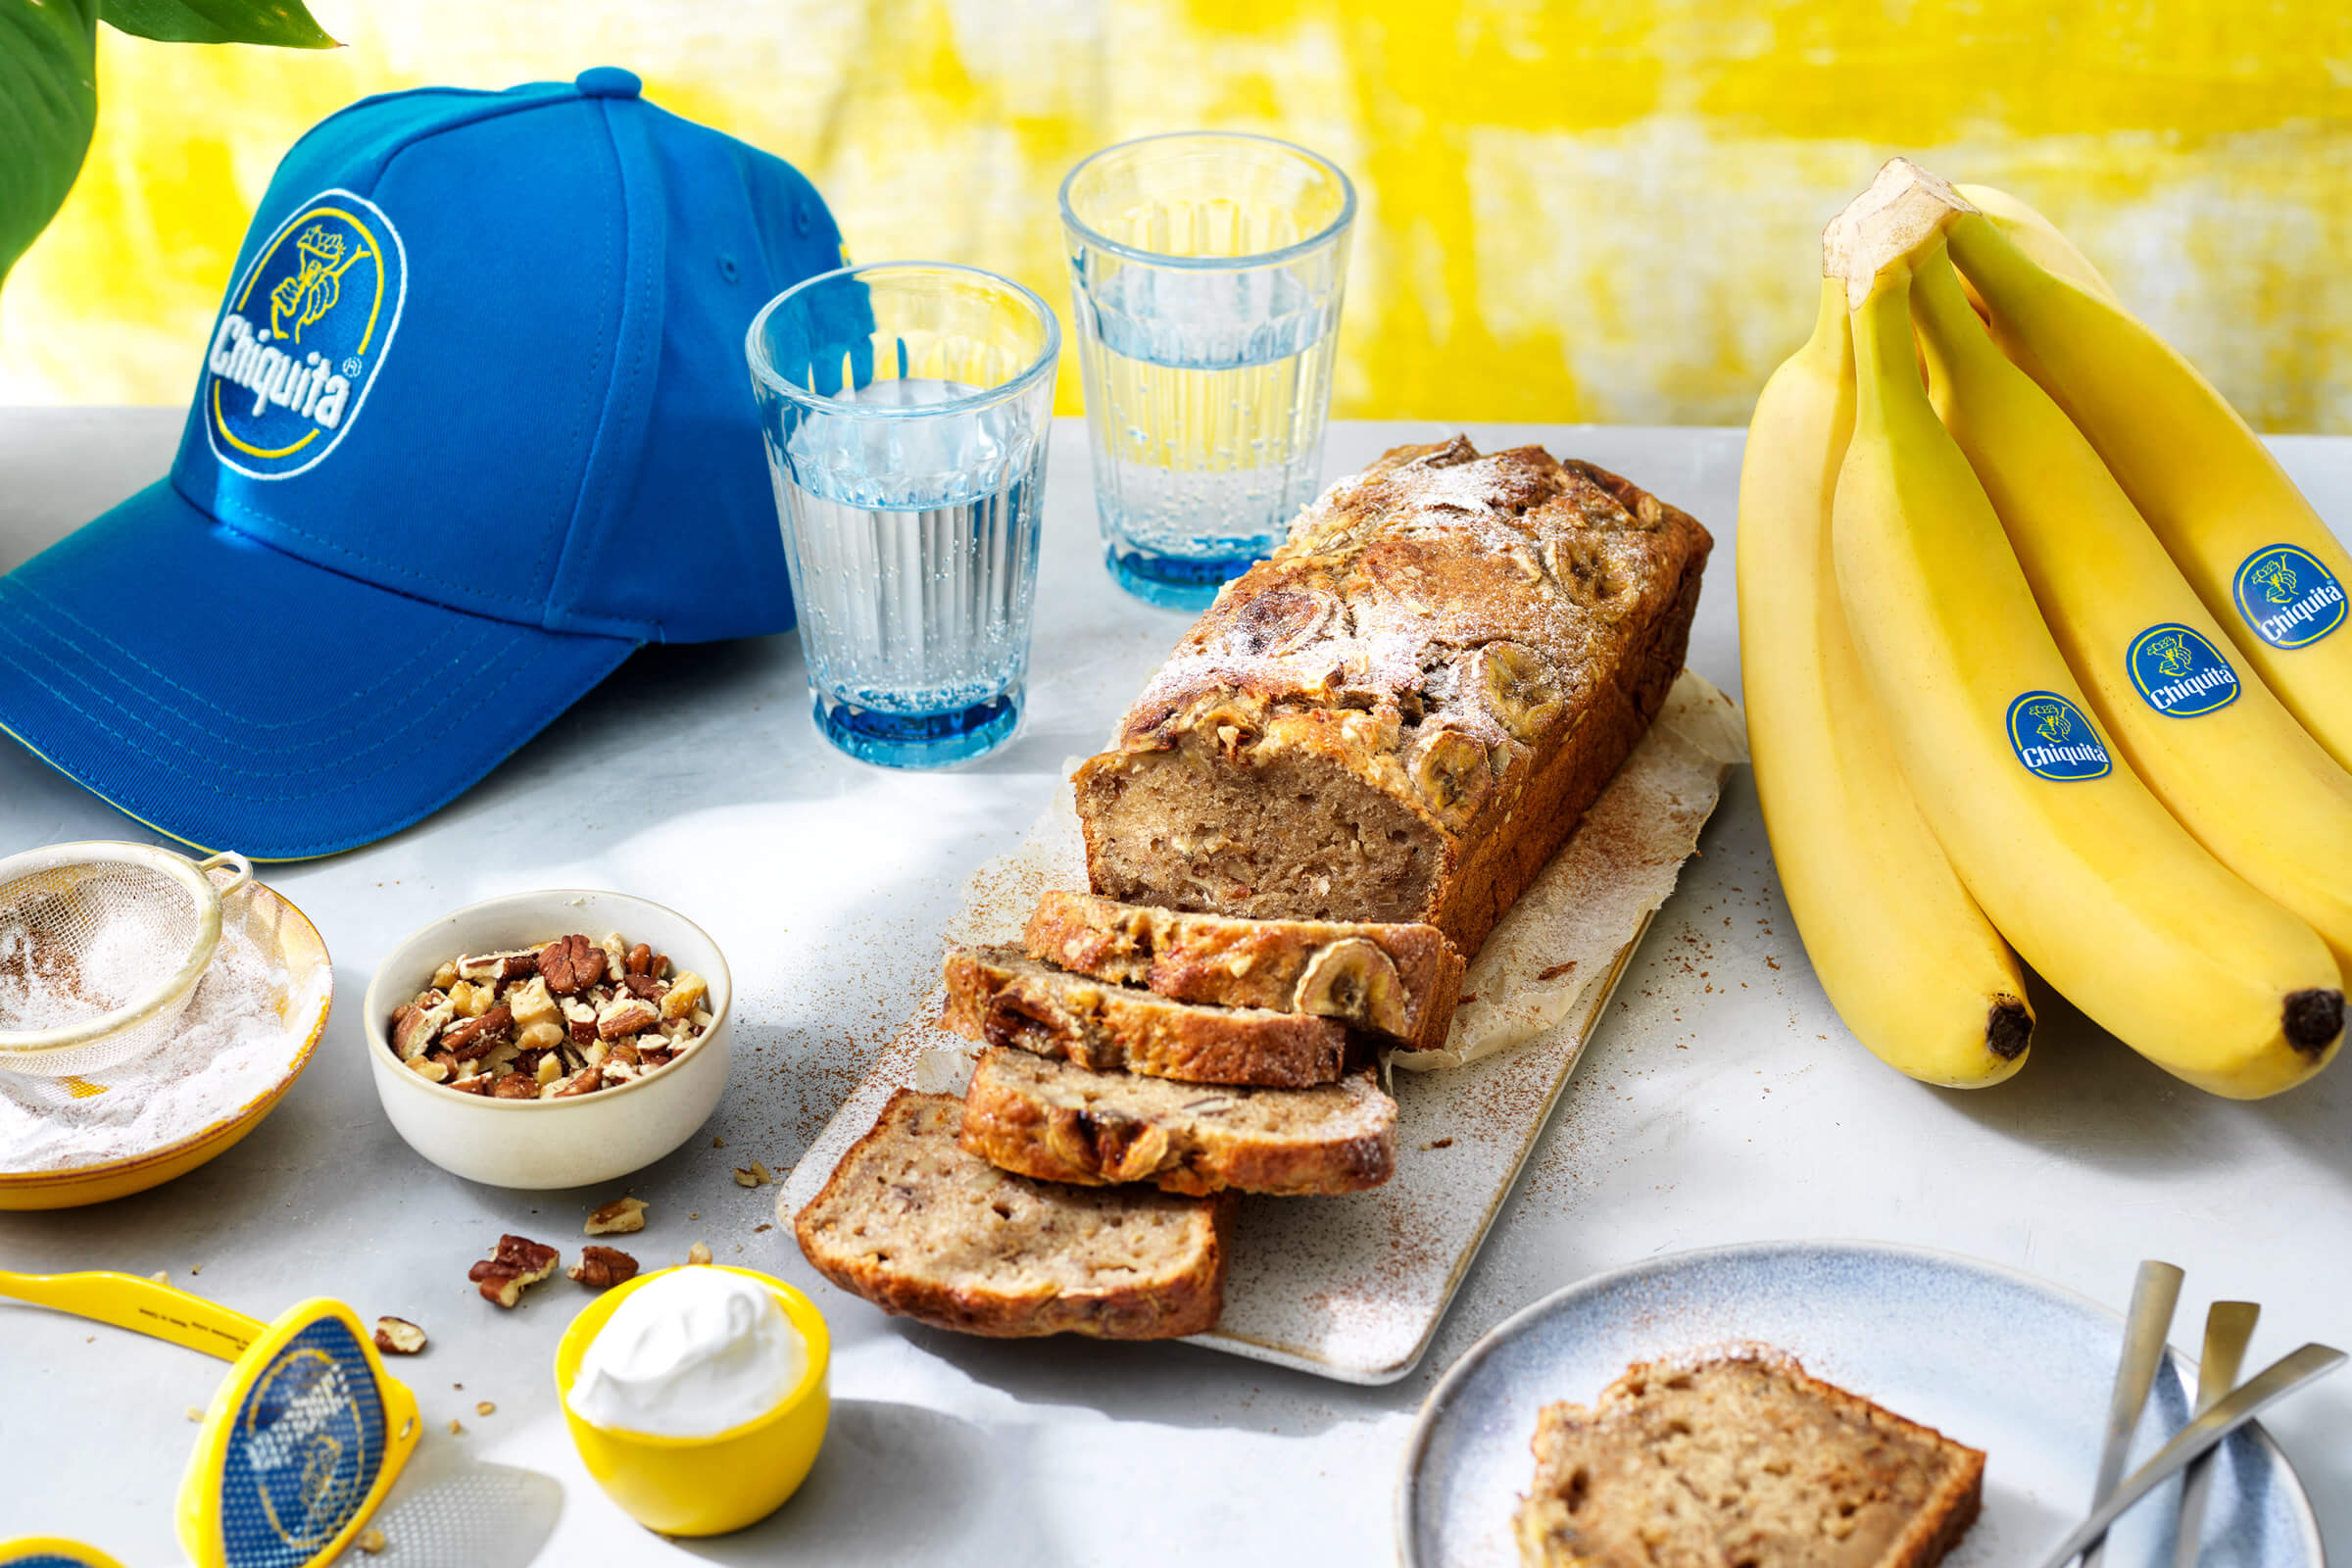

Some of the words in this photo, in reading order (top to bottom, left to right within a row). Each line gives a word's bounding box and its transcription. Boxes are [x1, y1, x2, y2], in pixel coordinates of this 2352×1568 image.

[2261, 585, 2344, 641] Chiquita
[2150, 666, 2236, 710] Chiquita
[2022, 743, 2109, 767] Chiquita
